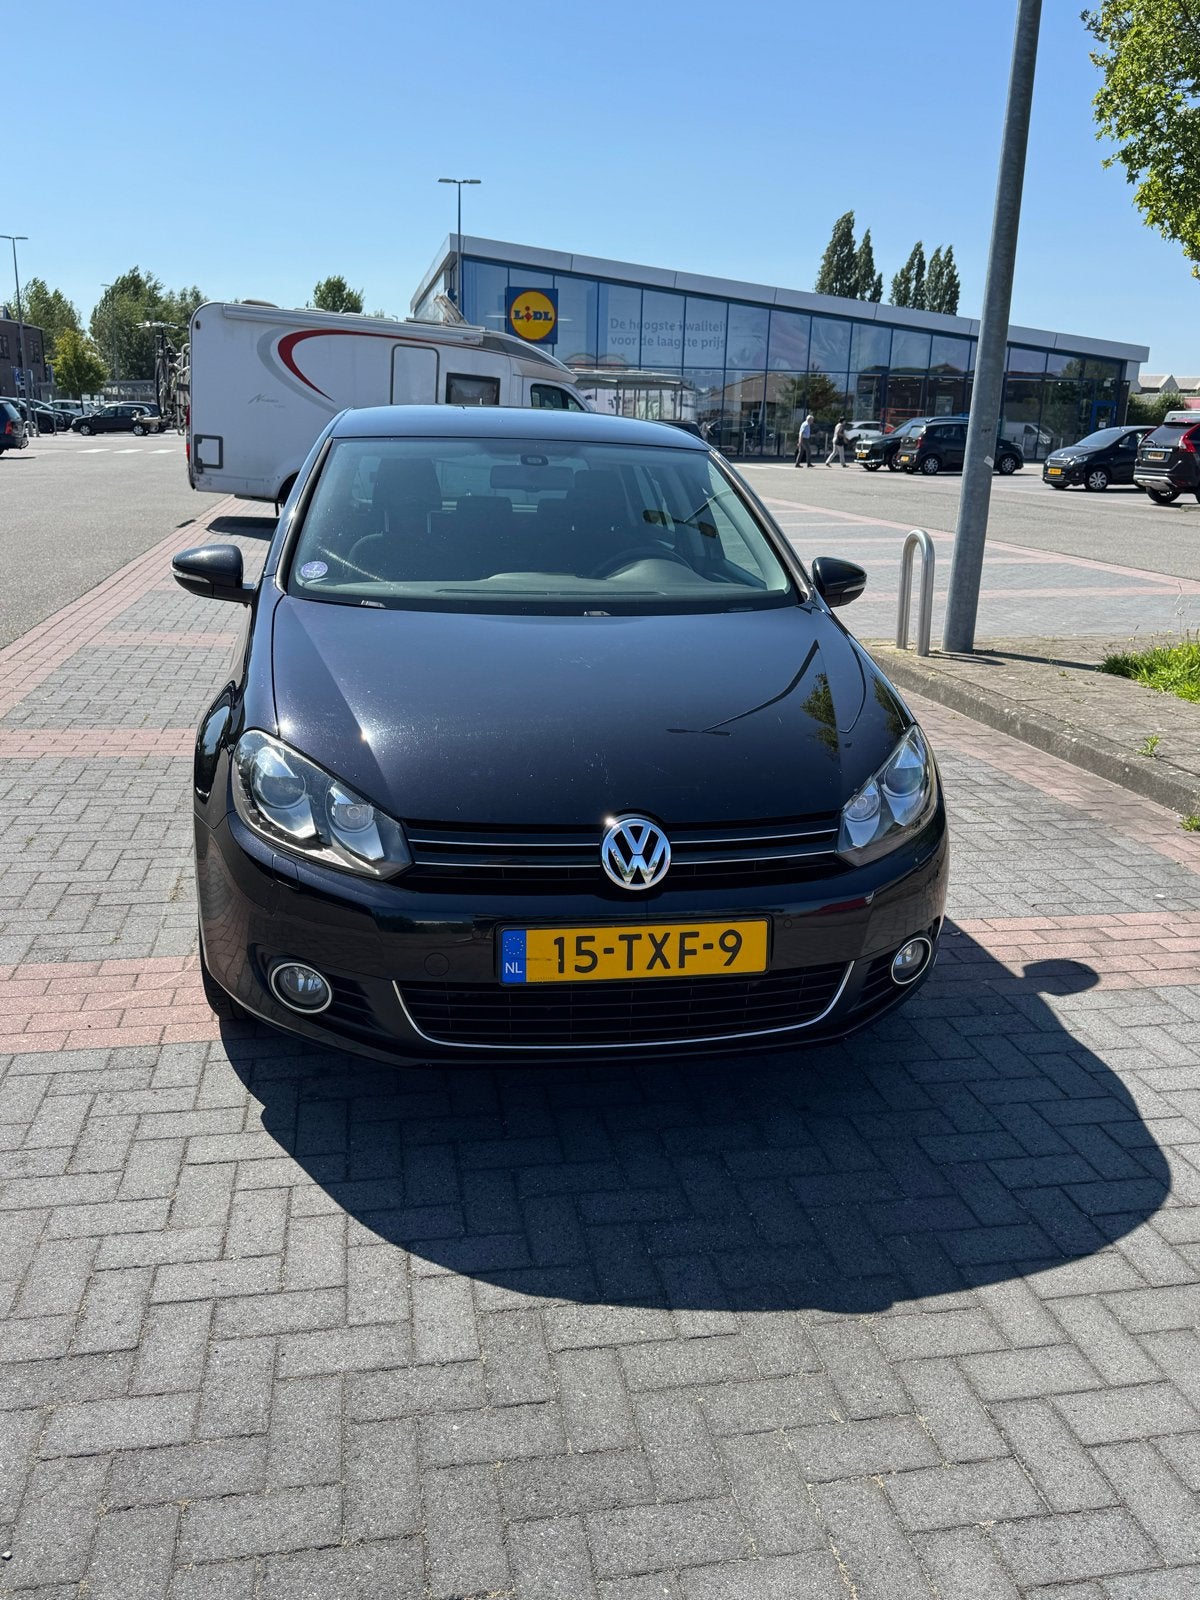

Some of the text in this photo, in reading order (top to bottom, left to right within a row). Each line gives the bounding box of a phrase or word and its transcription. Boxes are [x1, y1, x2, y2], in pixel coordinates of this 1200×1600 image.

[610, 318, 626, 329] De
[611, 336, 637, 346] voor
[640, 336, 654, 347] de
[701, 337, 726, 350] prijs
[505, 929, 743, 974] NL 15-TXF-9
